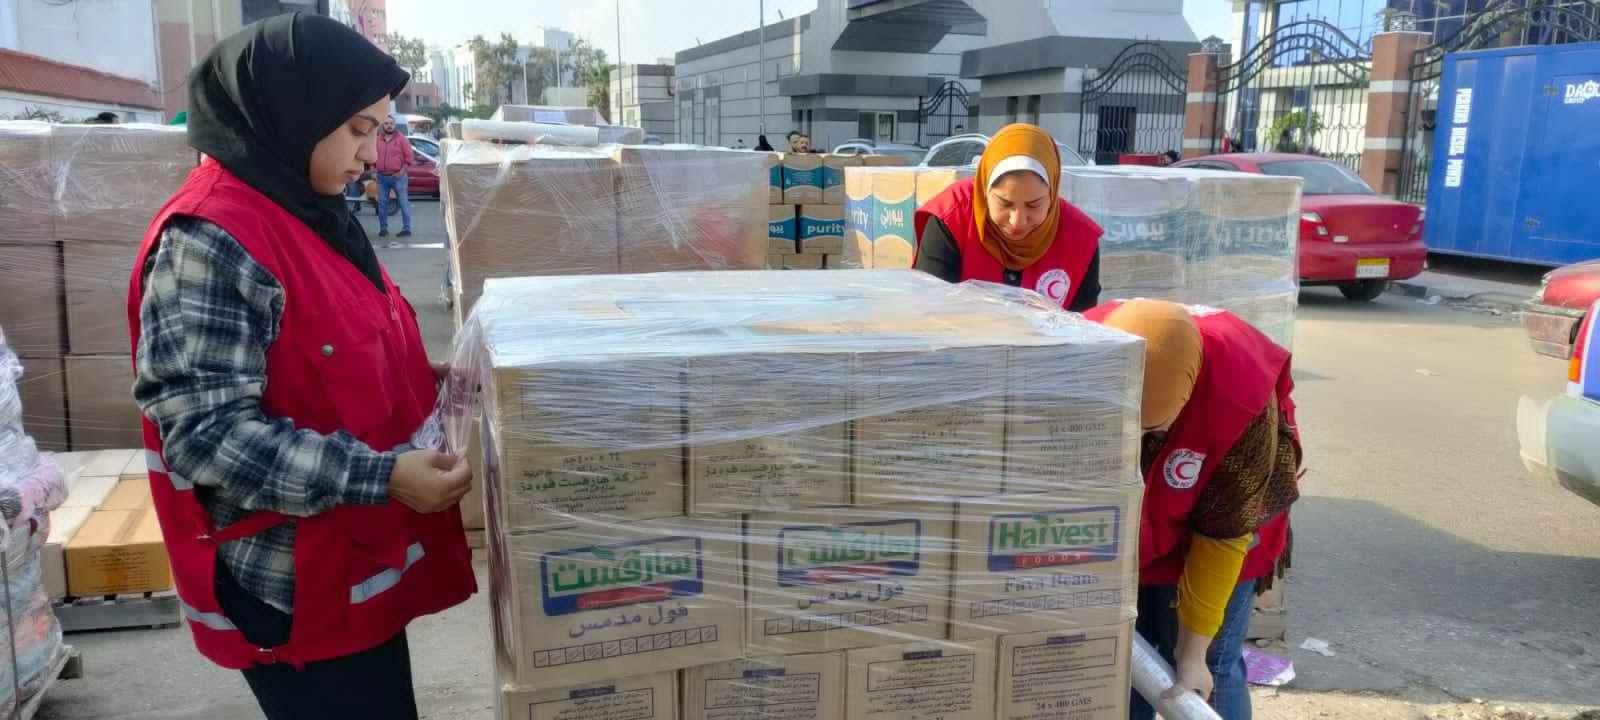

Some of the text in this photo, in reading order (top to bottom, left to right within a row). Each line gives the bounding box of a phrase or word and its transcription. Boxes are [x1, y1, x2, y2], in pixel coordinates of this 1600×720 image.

[999, 517, 1108, 549] Harvest
[1051, 574, 1099, 588] Beans
[568, 602, 689, 638] فول مدمس
